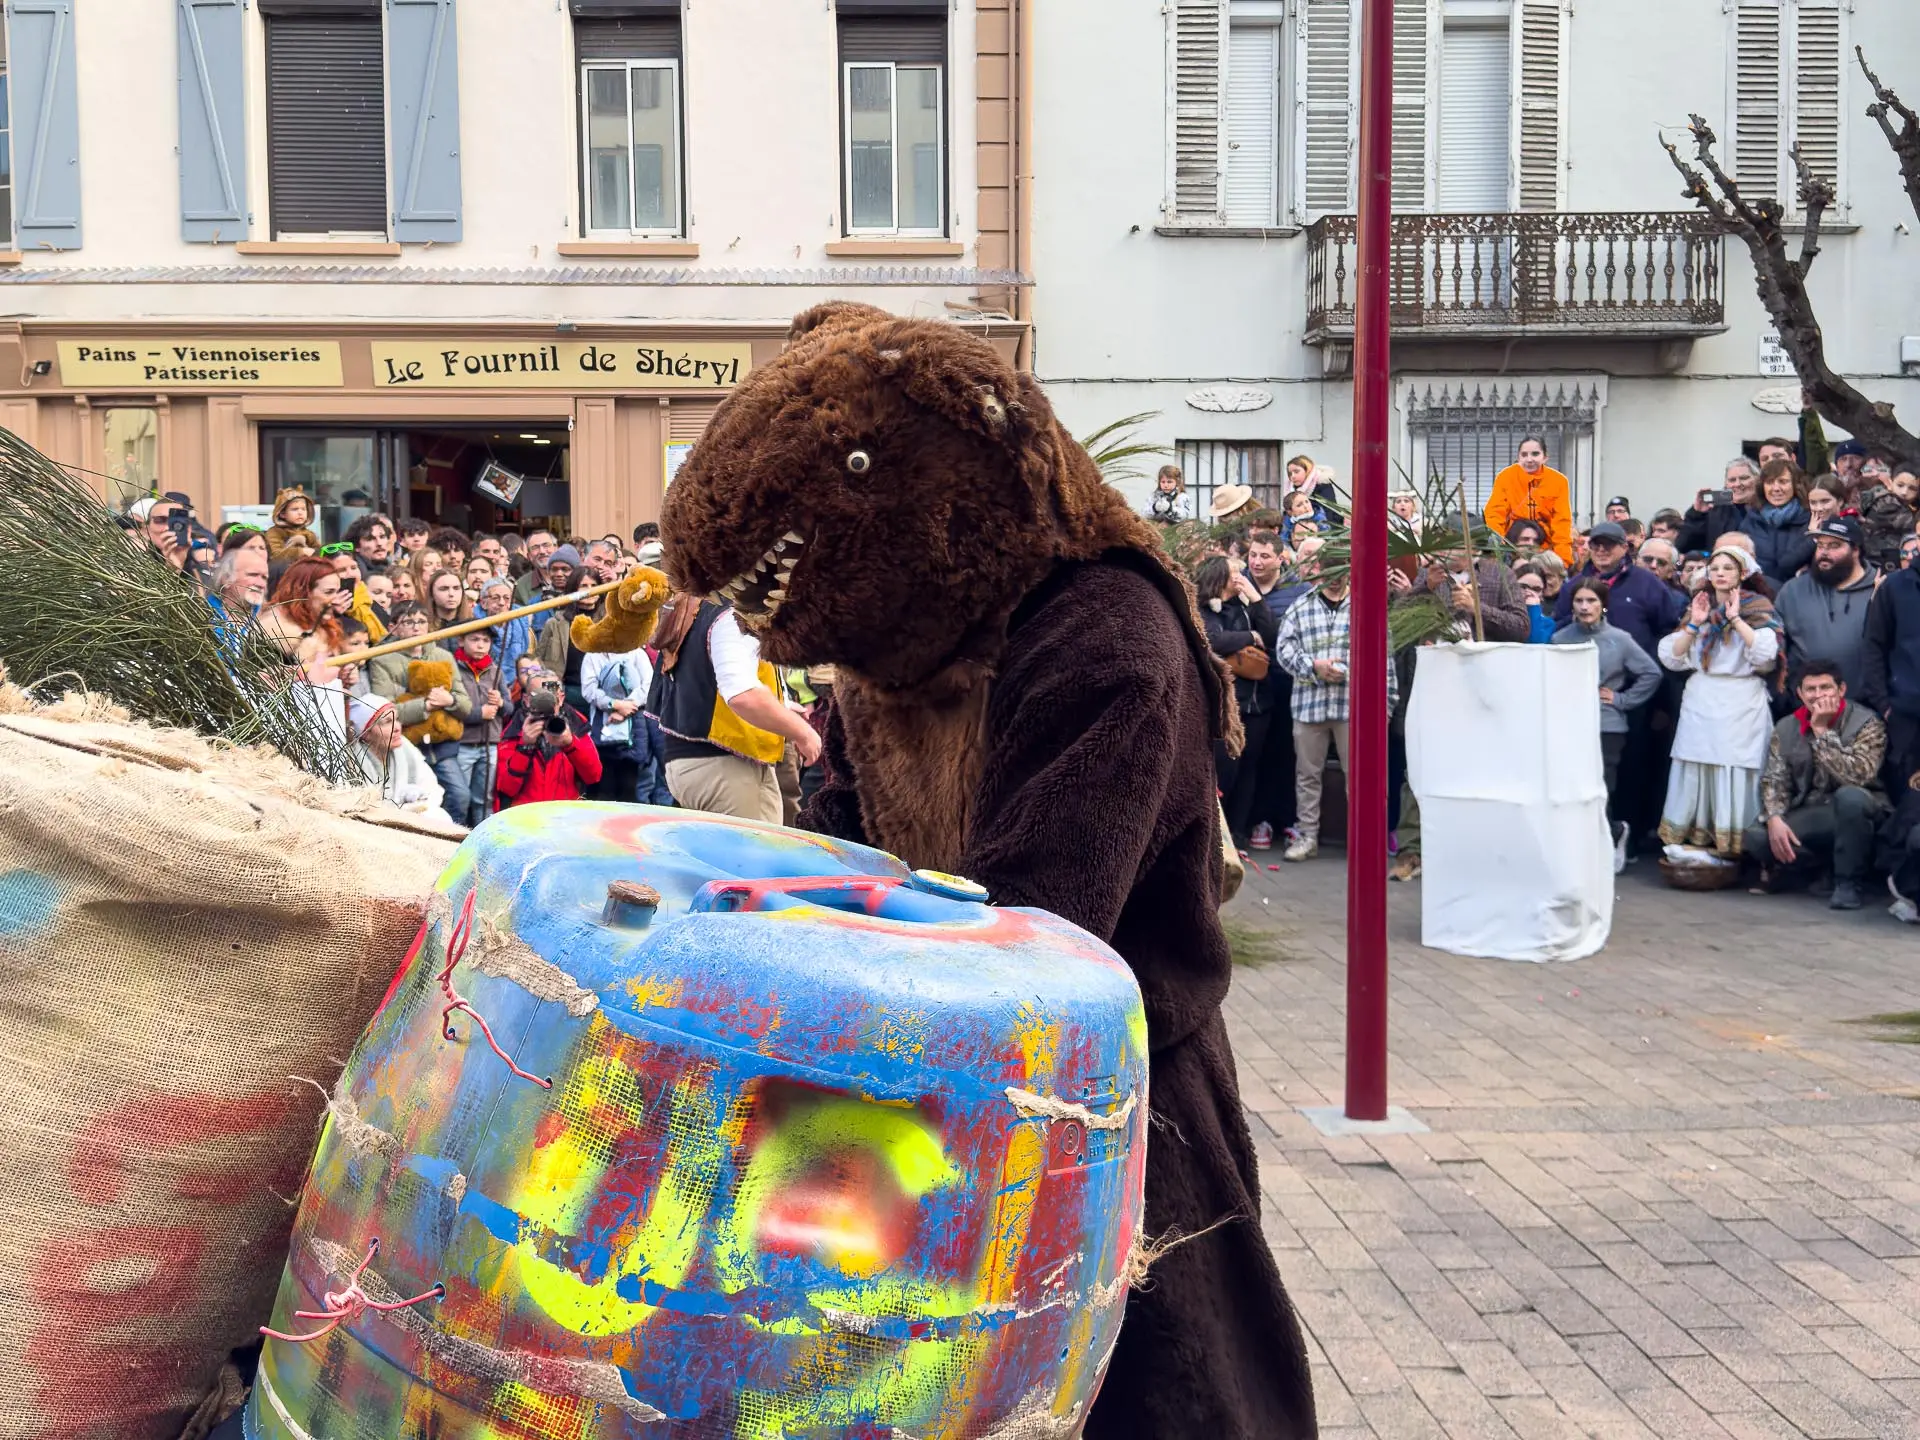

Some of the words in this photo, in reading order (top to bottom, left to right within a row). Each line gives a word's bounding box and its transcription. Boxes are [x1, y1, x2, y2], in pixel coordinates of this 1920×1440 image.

[77, 347, 137, 362] Pains
[172, 347, 321, 362] Viennoiseries
[383, 356, 422, 384] Le
[440, 346, 560, 377] Fournil
[579, 346, 617, 372] de
[636, 348, 740, 386] Shéryl
